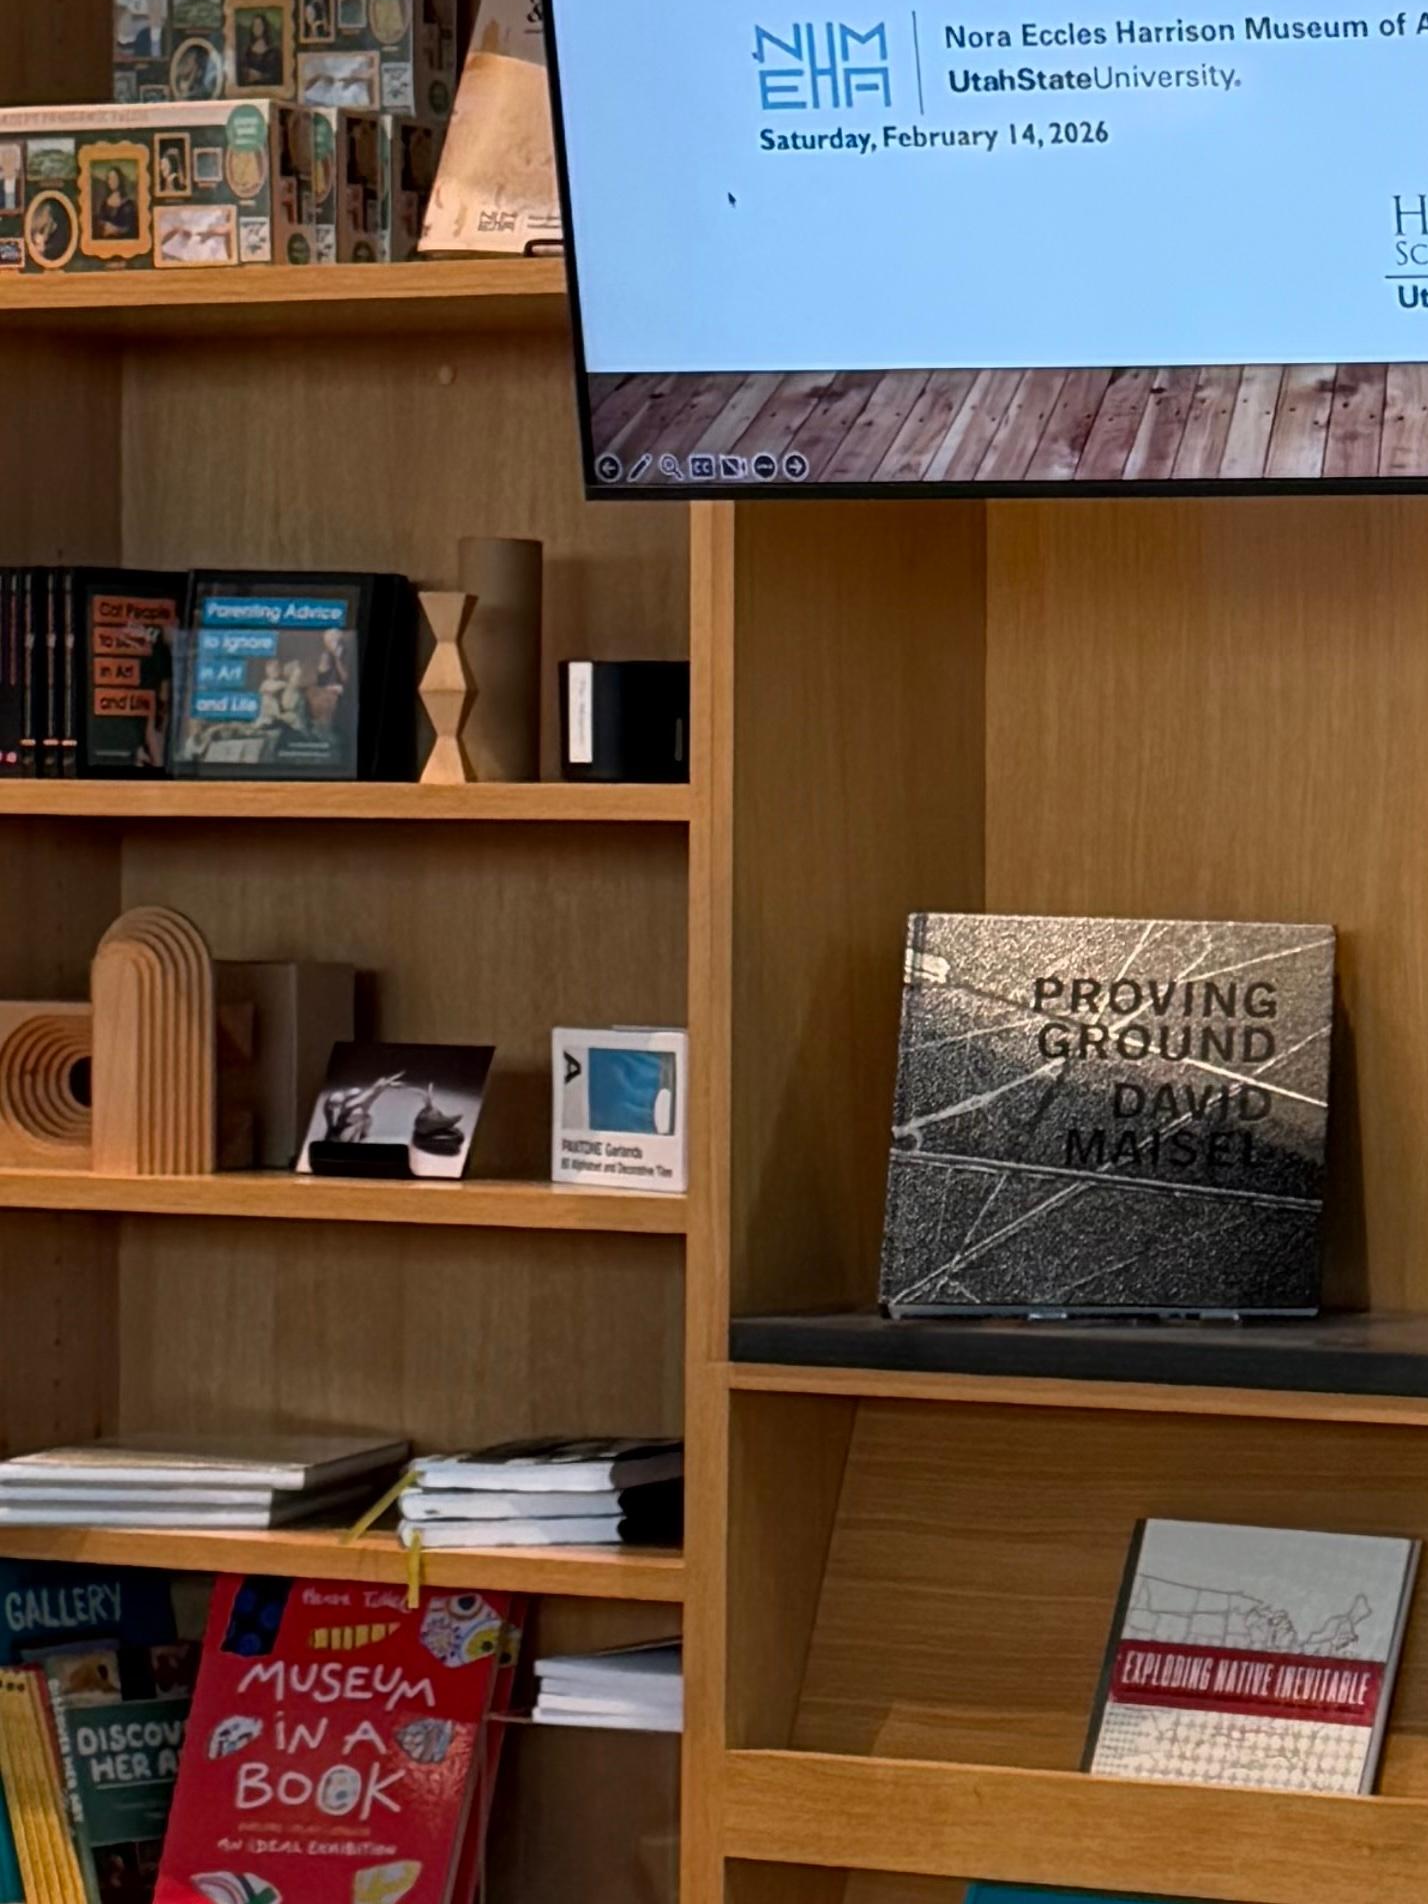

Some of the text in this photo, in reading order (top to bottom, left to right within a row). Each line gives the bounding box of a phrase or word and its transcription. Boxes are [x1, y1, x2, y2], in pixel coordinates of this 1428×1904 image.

[946, 26, 1011, 48] Nora
[1022, 23, 1106, 46] Eccles
[1116, 19, 1234, 43] Harrison
[1245, 17, 1368, 39] Museum
[1380, 13, 1405, 36] of
[760, 121, 1108, 154] Saturday, February 14, 2026
[206, 602, 343, 623] Parenting Advice
[1033, 976, 1277, 1018] PROVING
[1038, 1023, 1276, 1063] GROUND
[1113, 1082, 1272, 1122] DAVID
[1065, 1128, 1262, 1168] MAISEL
[5, 1582, 121, 1631] GALLERY
[237, 1660, 436, 1711] MUSEUM
[1122, 1650, 1372, 1705] EXPLODING NATIVE INEVITABLE
[78, 1722, 186, 1757] DISCOV
[341, 1720, 388, 1755] A
[91, 1750, 152, 1783] HER
[235, 1761, 406, 1821] BOOK
